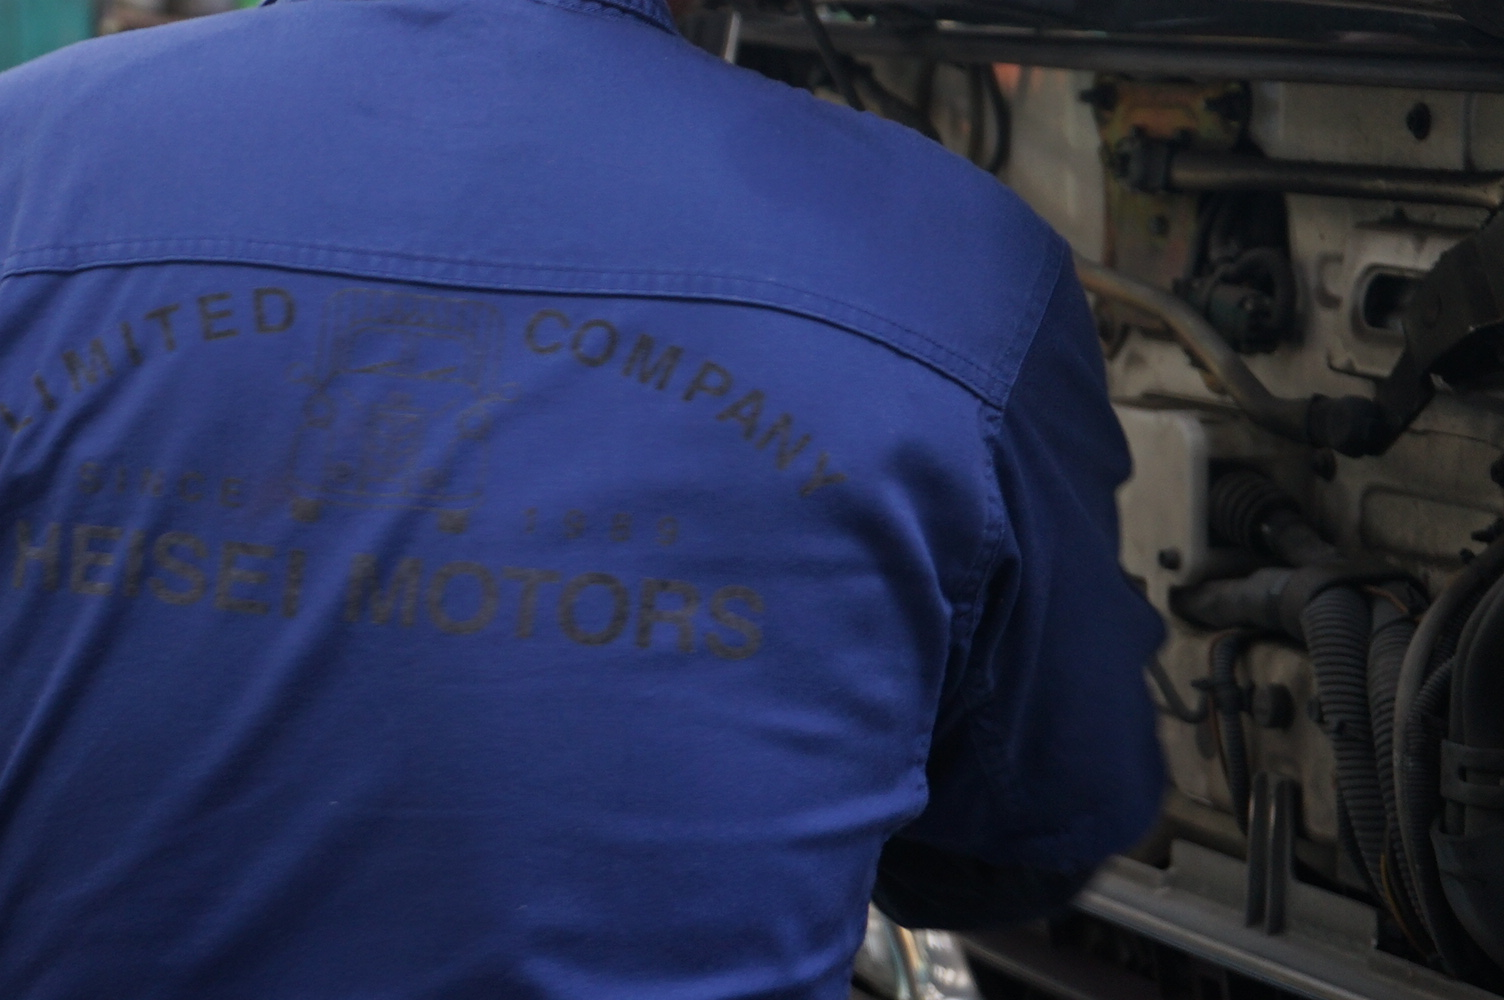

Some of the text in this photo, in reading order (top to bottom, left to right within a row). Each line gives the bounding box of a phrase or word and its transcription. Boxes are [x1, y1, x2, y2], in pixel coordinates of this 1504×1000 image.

[524, 308, 848, 498] COMPANY
[77, 460, 681, 547] SINCE 1989
[12, 519, 765, 661] HEISEI MOTORS
